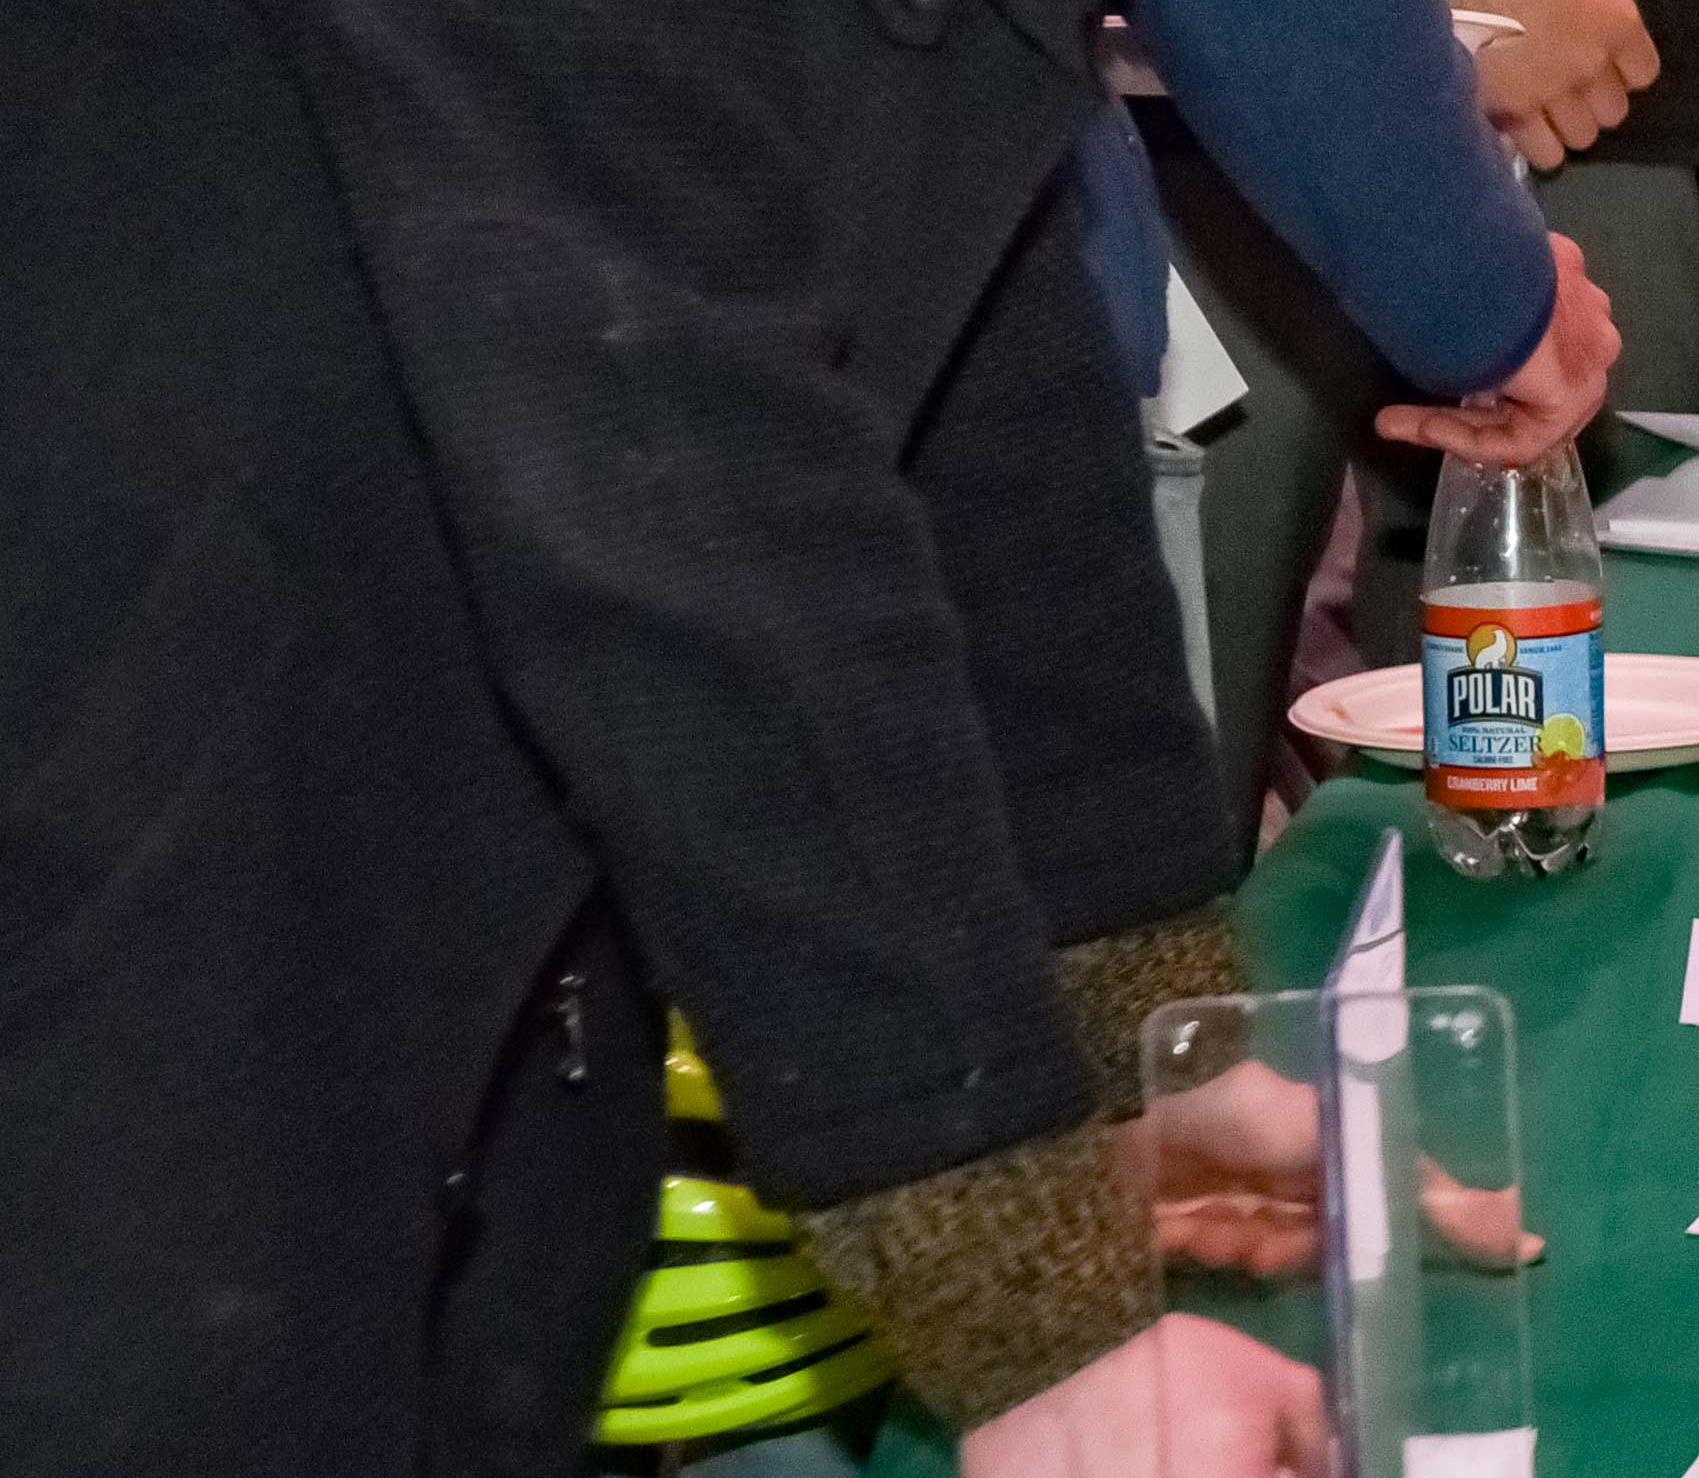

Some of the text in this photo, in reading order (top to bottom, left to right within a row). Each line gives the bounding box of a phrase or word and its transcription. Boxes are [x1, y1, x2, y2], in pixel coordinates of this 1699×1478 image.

[1453, 673, 1537, 720] POLAR
[1449, 734, 1543, 753] SELTZER
[1446, 775, 1538, 793] CRANBERRY LIME
